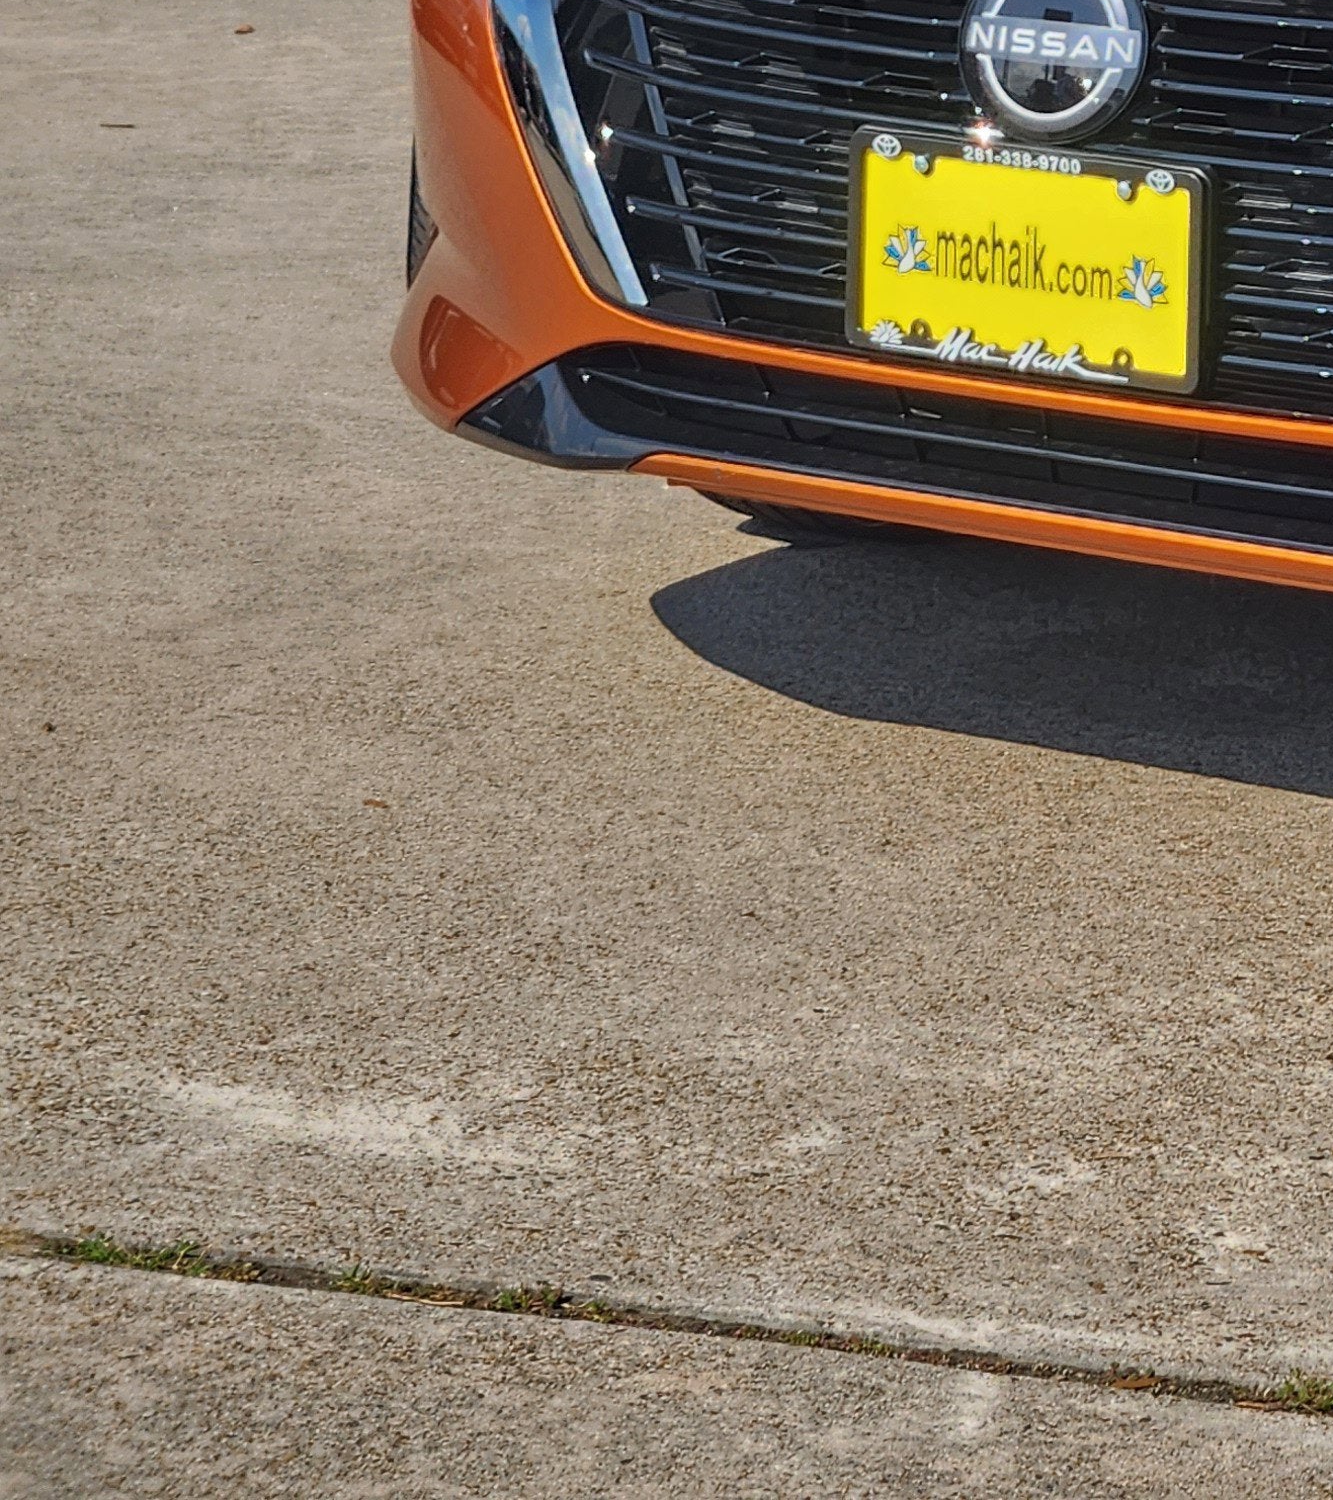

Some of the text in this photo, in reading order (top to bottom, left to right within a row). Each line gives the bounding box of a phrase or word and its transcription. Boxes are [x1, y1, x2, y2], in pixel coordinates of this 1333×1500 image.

[969, 20, 1135, 64] NISSAN
[962, 145, 1082, 175] 281-338-9700
[934, 221, 1114, 300] machaik.com
